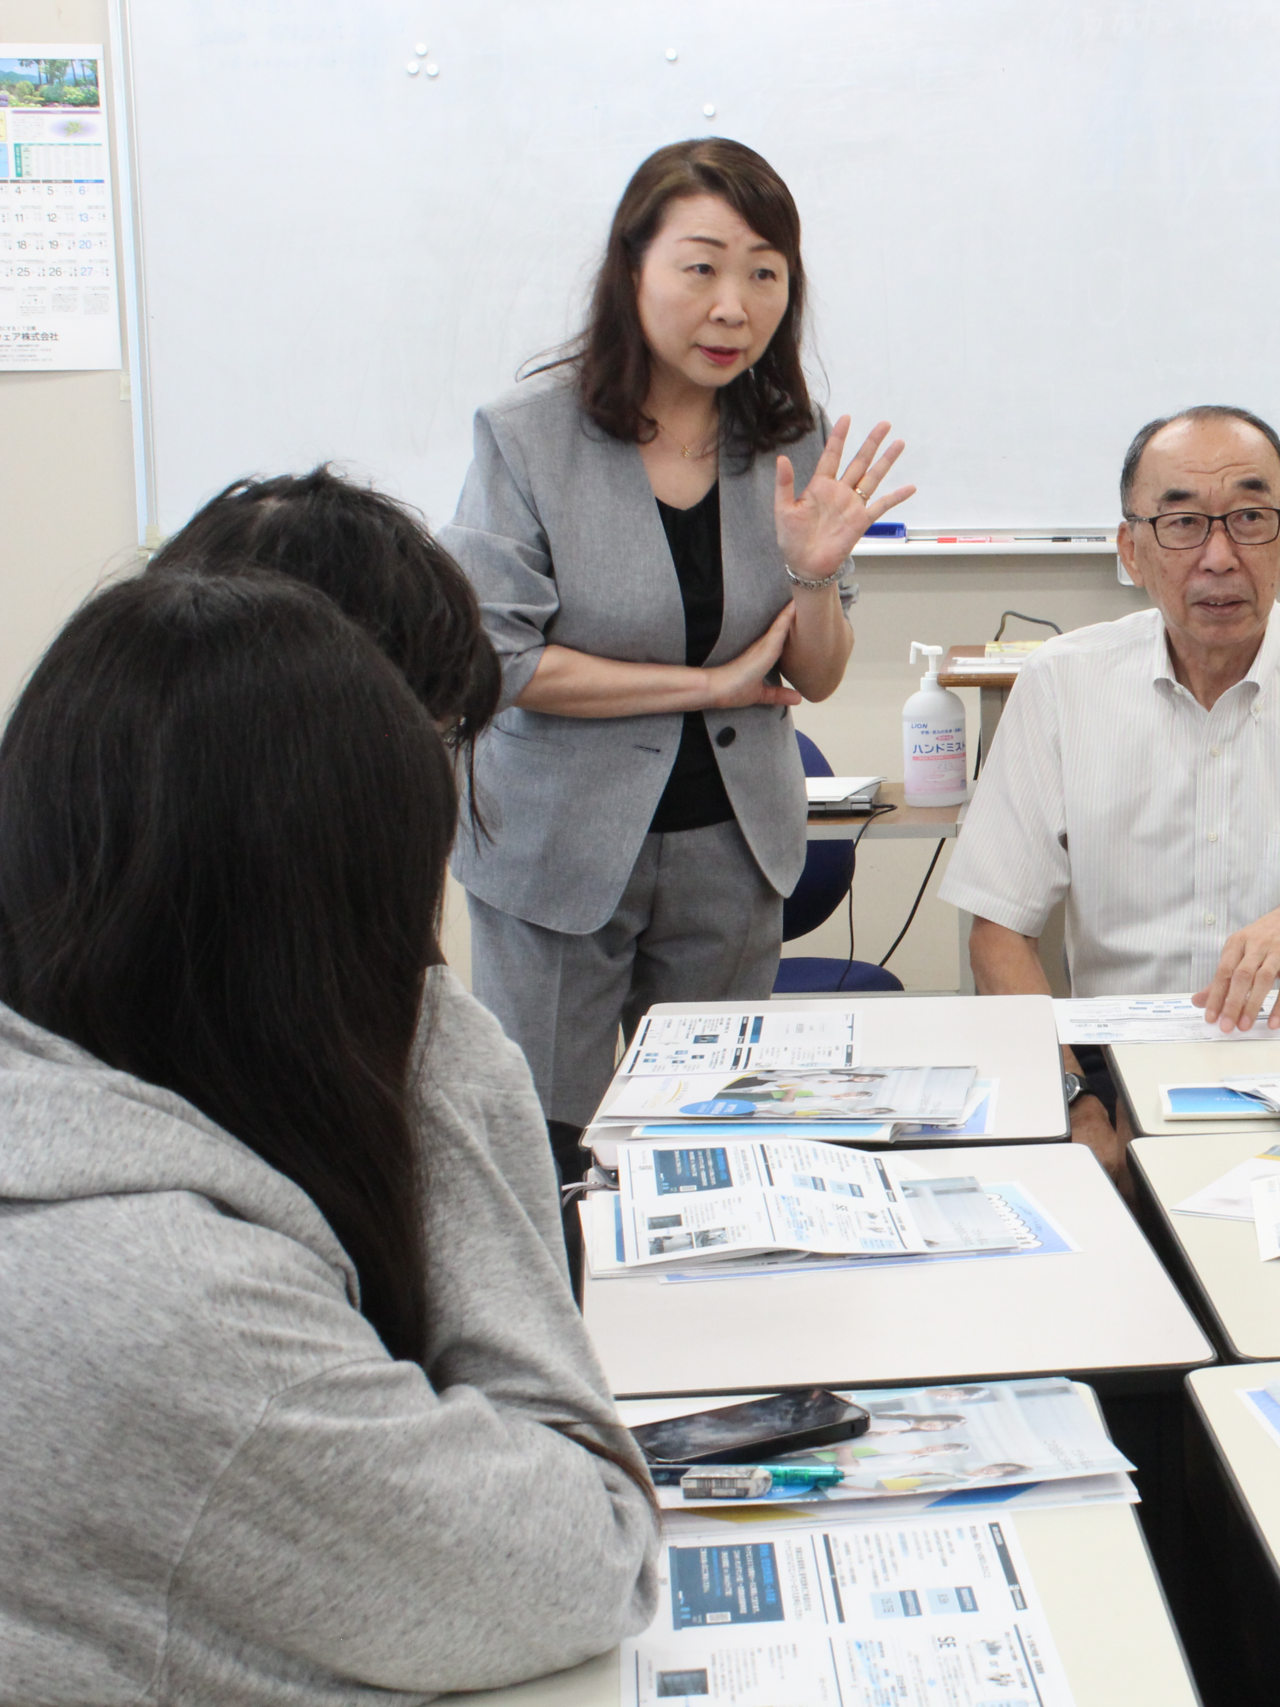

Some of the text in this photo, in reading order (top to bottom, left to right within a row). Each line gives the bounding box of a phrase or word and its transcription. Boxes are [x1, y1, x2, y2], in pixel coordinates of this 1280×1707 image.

[15, 186, 21, 194] 4
[47, 186, 54, 195] 5
[78, 186, 86, 195] 6
[15, 213, 24, 222] 11
[46, 213, 57, 222] 12
[79, 213, 89, 222] 13
[16, 240, 27, 249] 18
[48, 240, 59, 249] 19
[79, 240, 92, 249] 20
[17, 267, 30, 276] 25
[49, 267, 62, 276] 26
[80, 267, 93, 276] 27
[0, 331, 59, 341] ェア株式会社
[912, 741, 966, 754] ハンドミスト
[937, 1635, 957, 1649] SE
